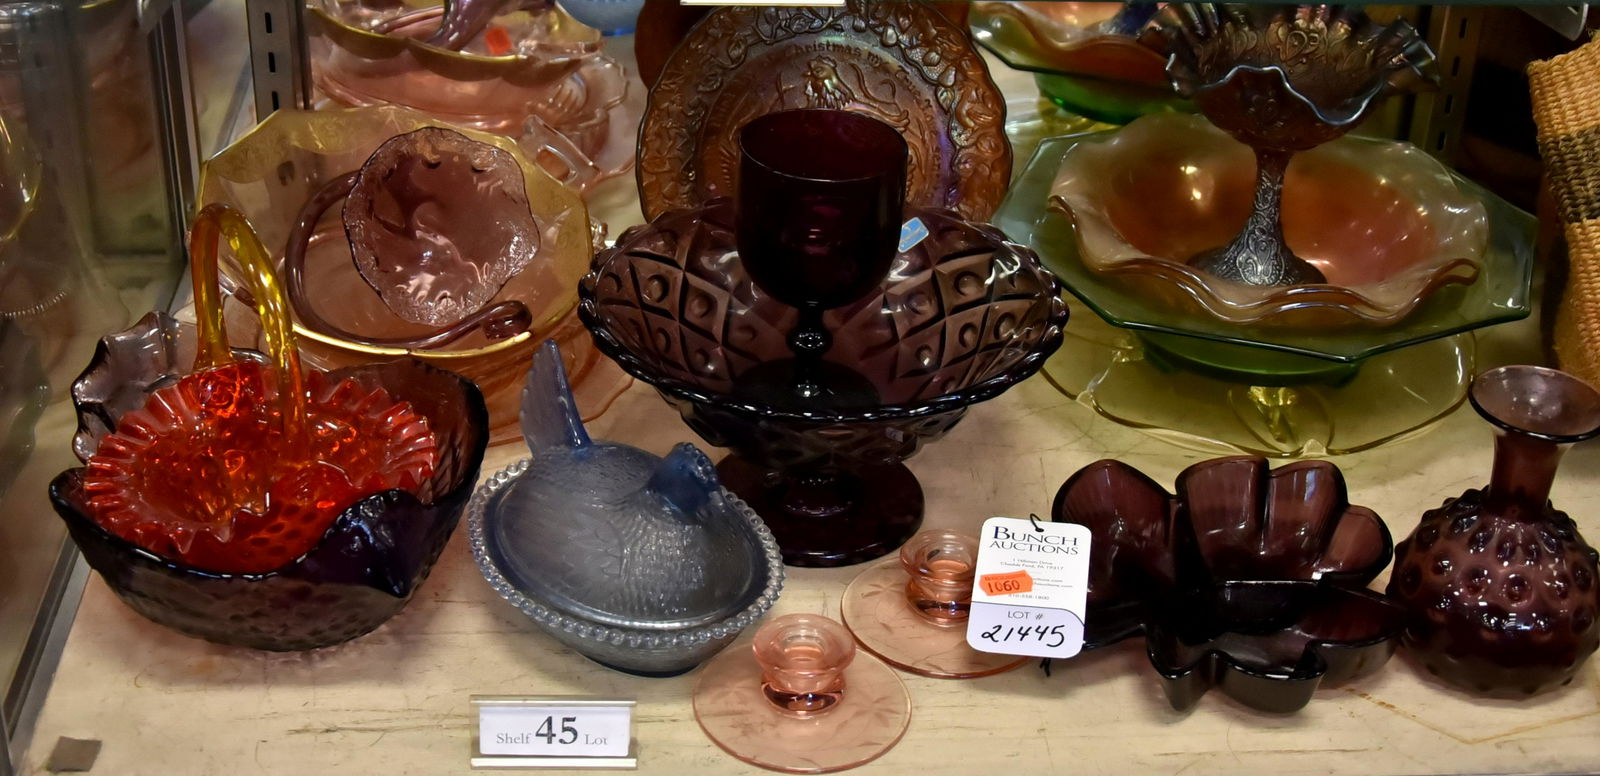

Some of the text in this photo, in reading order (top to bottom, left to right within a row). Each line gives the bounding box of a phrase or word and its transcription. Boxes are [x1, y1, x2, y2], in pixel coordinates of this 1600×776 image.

[993, 526, 1077, 546] BUNCH
[989, 540, 1079, 555] AUCTIONS
[988, 579, 1020, 593] 1060
[1007, 610, 1030, 619] LOT
[981, 624, 1065, 648] 21445
[496, 715, 608, 745] Shelf 45 Lot
